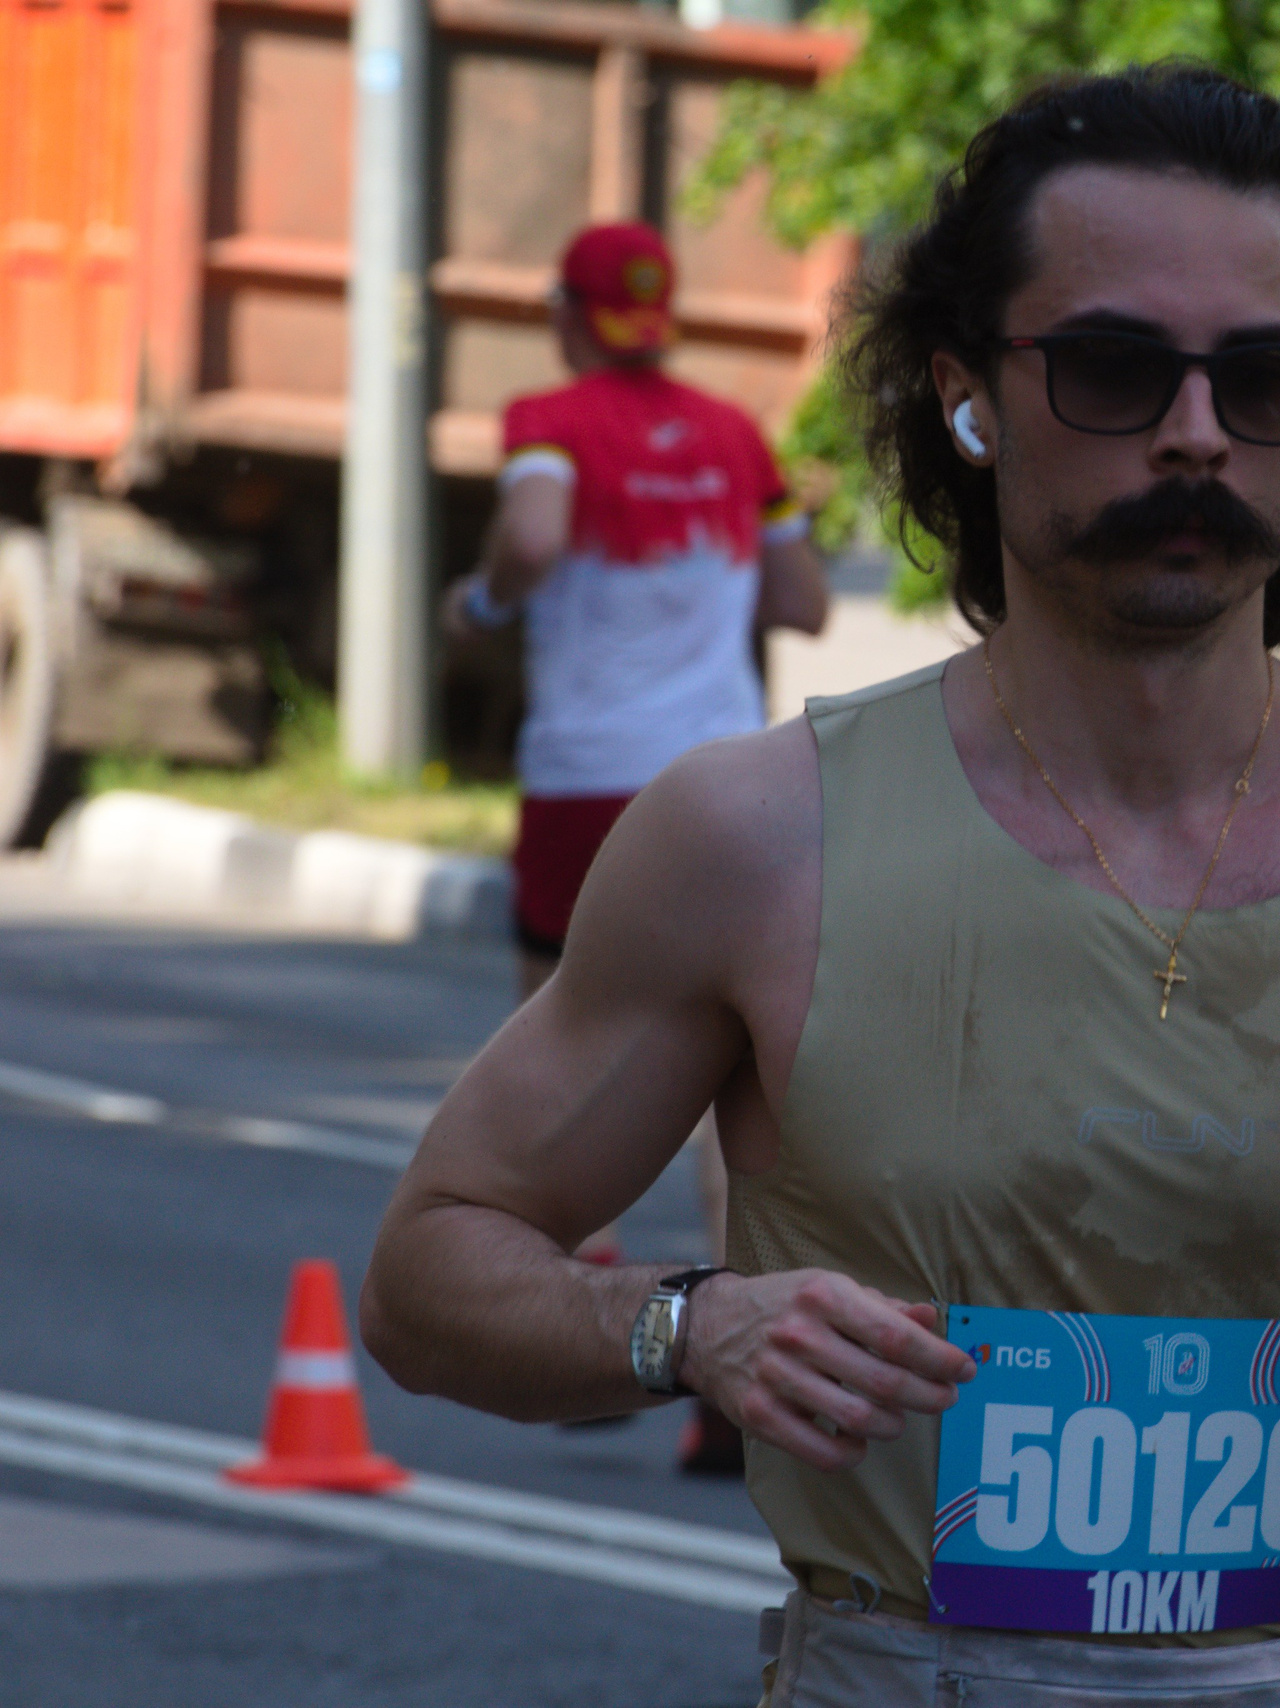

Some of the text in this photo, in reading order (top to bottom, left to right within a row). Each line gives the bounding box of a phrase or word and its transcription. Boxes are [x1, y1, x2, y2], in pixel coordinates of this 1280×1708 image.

[996, 1346, 1052, 1369] ПСБ
[1142, 1332, 1211, 1396] 10
[1087, 1570, 1220, 1633] 10KM
